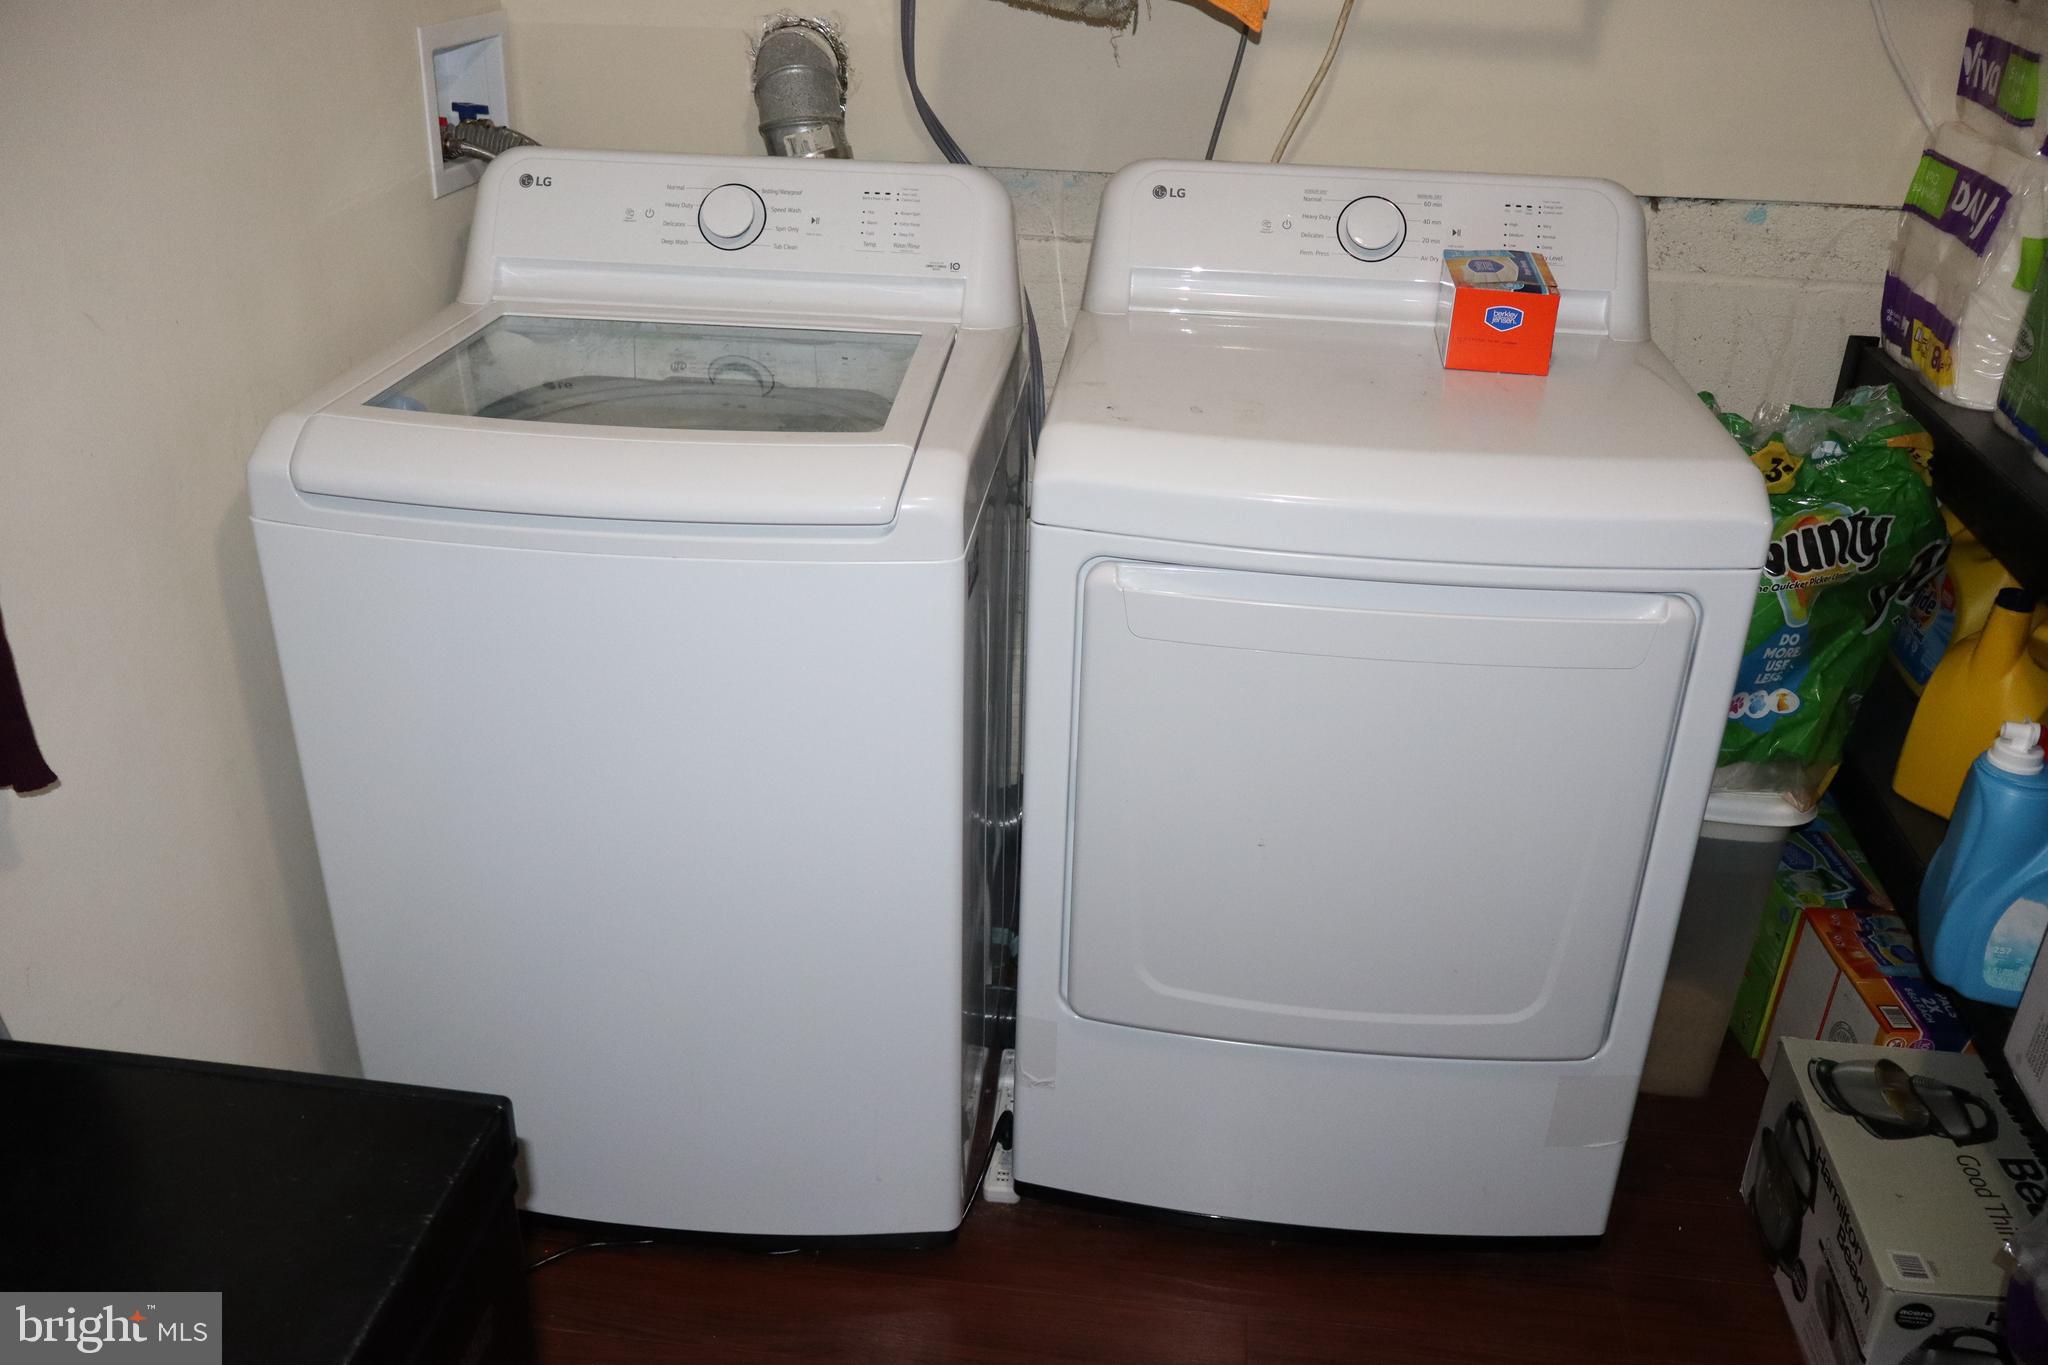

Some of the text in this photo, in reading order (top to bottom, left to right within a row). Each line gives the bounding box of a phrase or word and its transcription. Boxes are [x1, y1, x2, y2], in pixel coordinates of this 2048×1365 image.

[536, 176, 552, 187] LG
[1169, 188, 1186, 198] LG
[1764, 508, 1895, 577] ounty
[1771, 580, 1809, 593] Quicker
[1778, 633, 1801, 646] DO
[1762, 646, 1801, 659] MORE
[1956, 1154, 2001, 1198] Good
[1815, 1146, 1865, 1266] Hamilton
[1837, 1223, 1871, 1315] Beach
